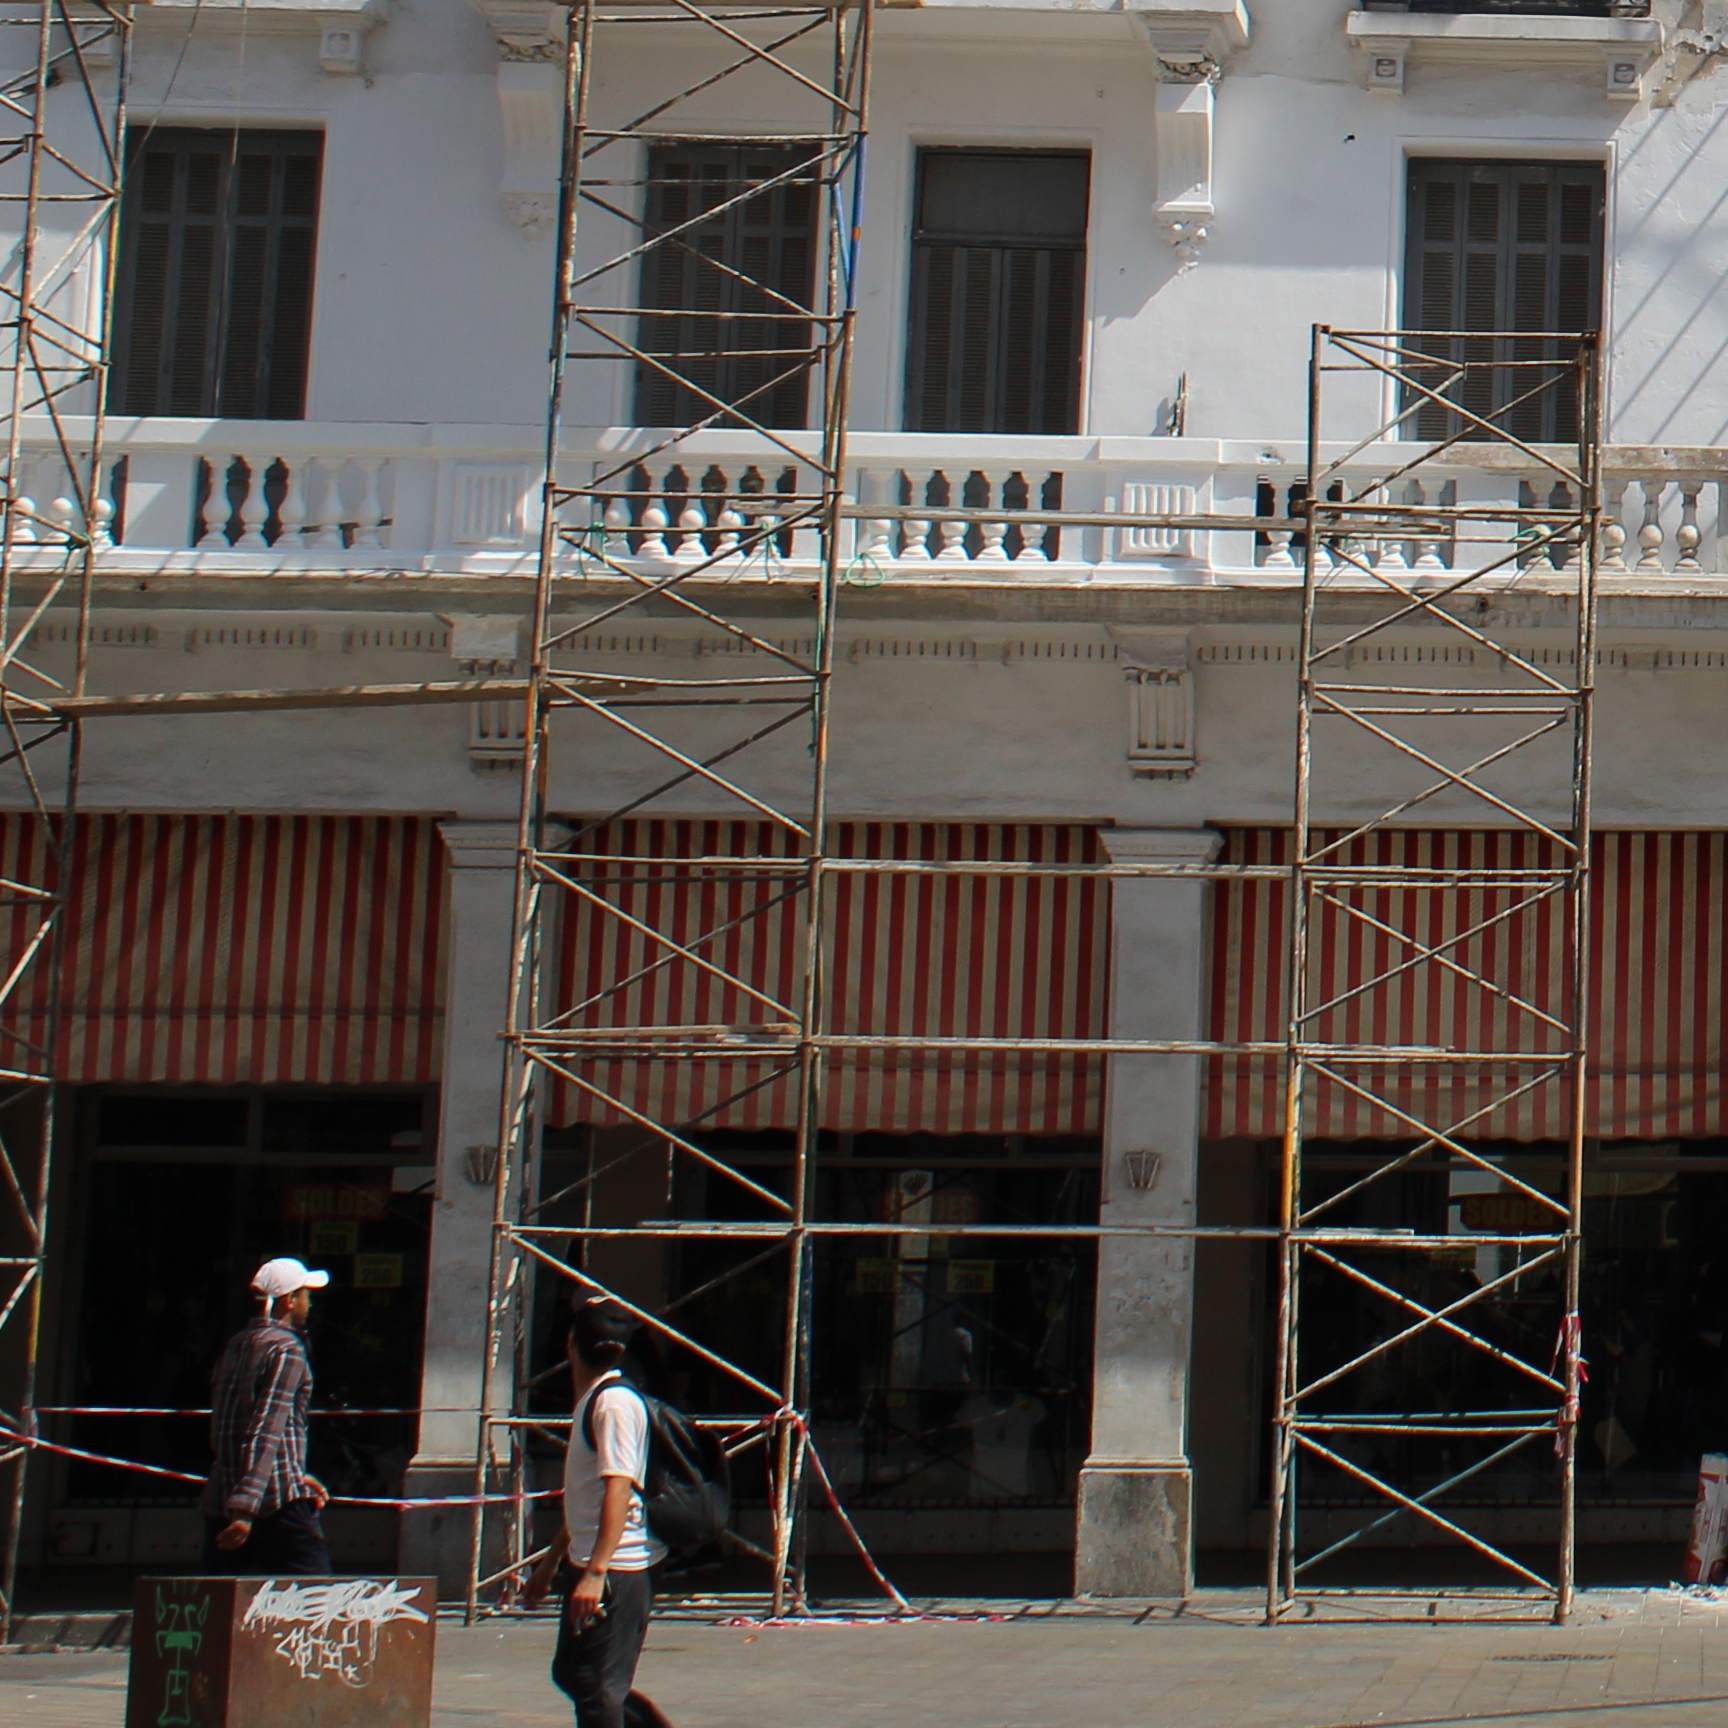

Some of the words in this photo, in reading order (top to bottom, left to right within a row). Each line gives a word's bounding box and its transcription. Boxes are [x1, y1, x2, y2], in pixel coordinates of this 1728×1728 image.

[292, 1188, 385, 1215] SOLDES
[1466, 1197, 1555, 1227] SOLDES
[953, 1273, 985, 1289] 250
